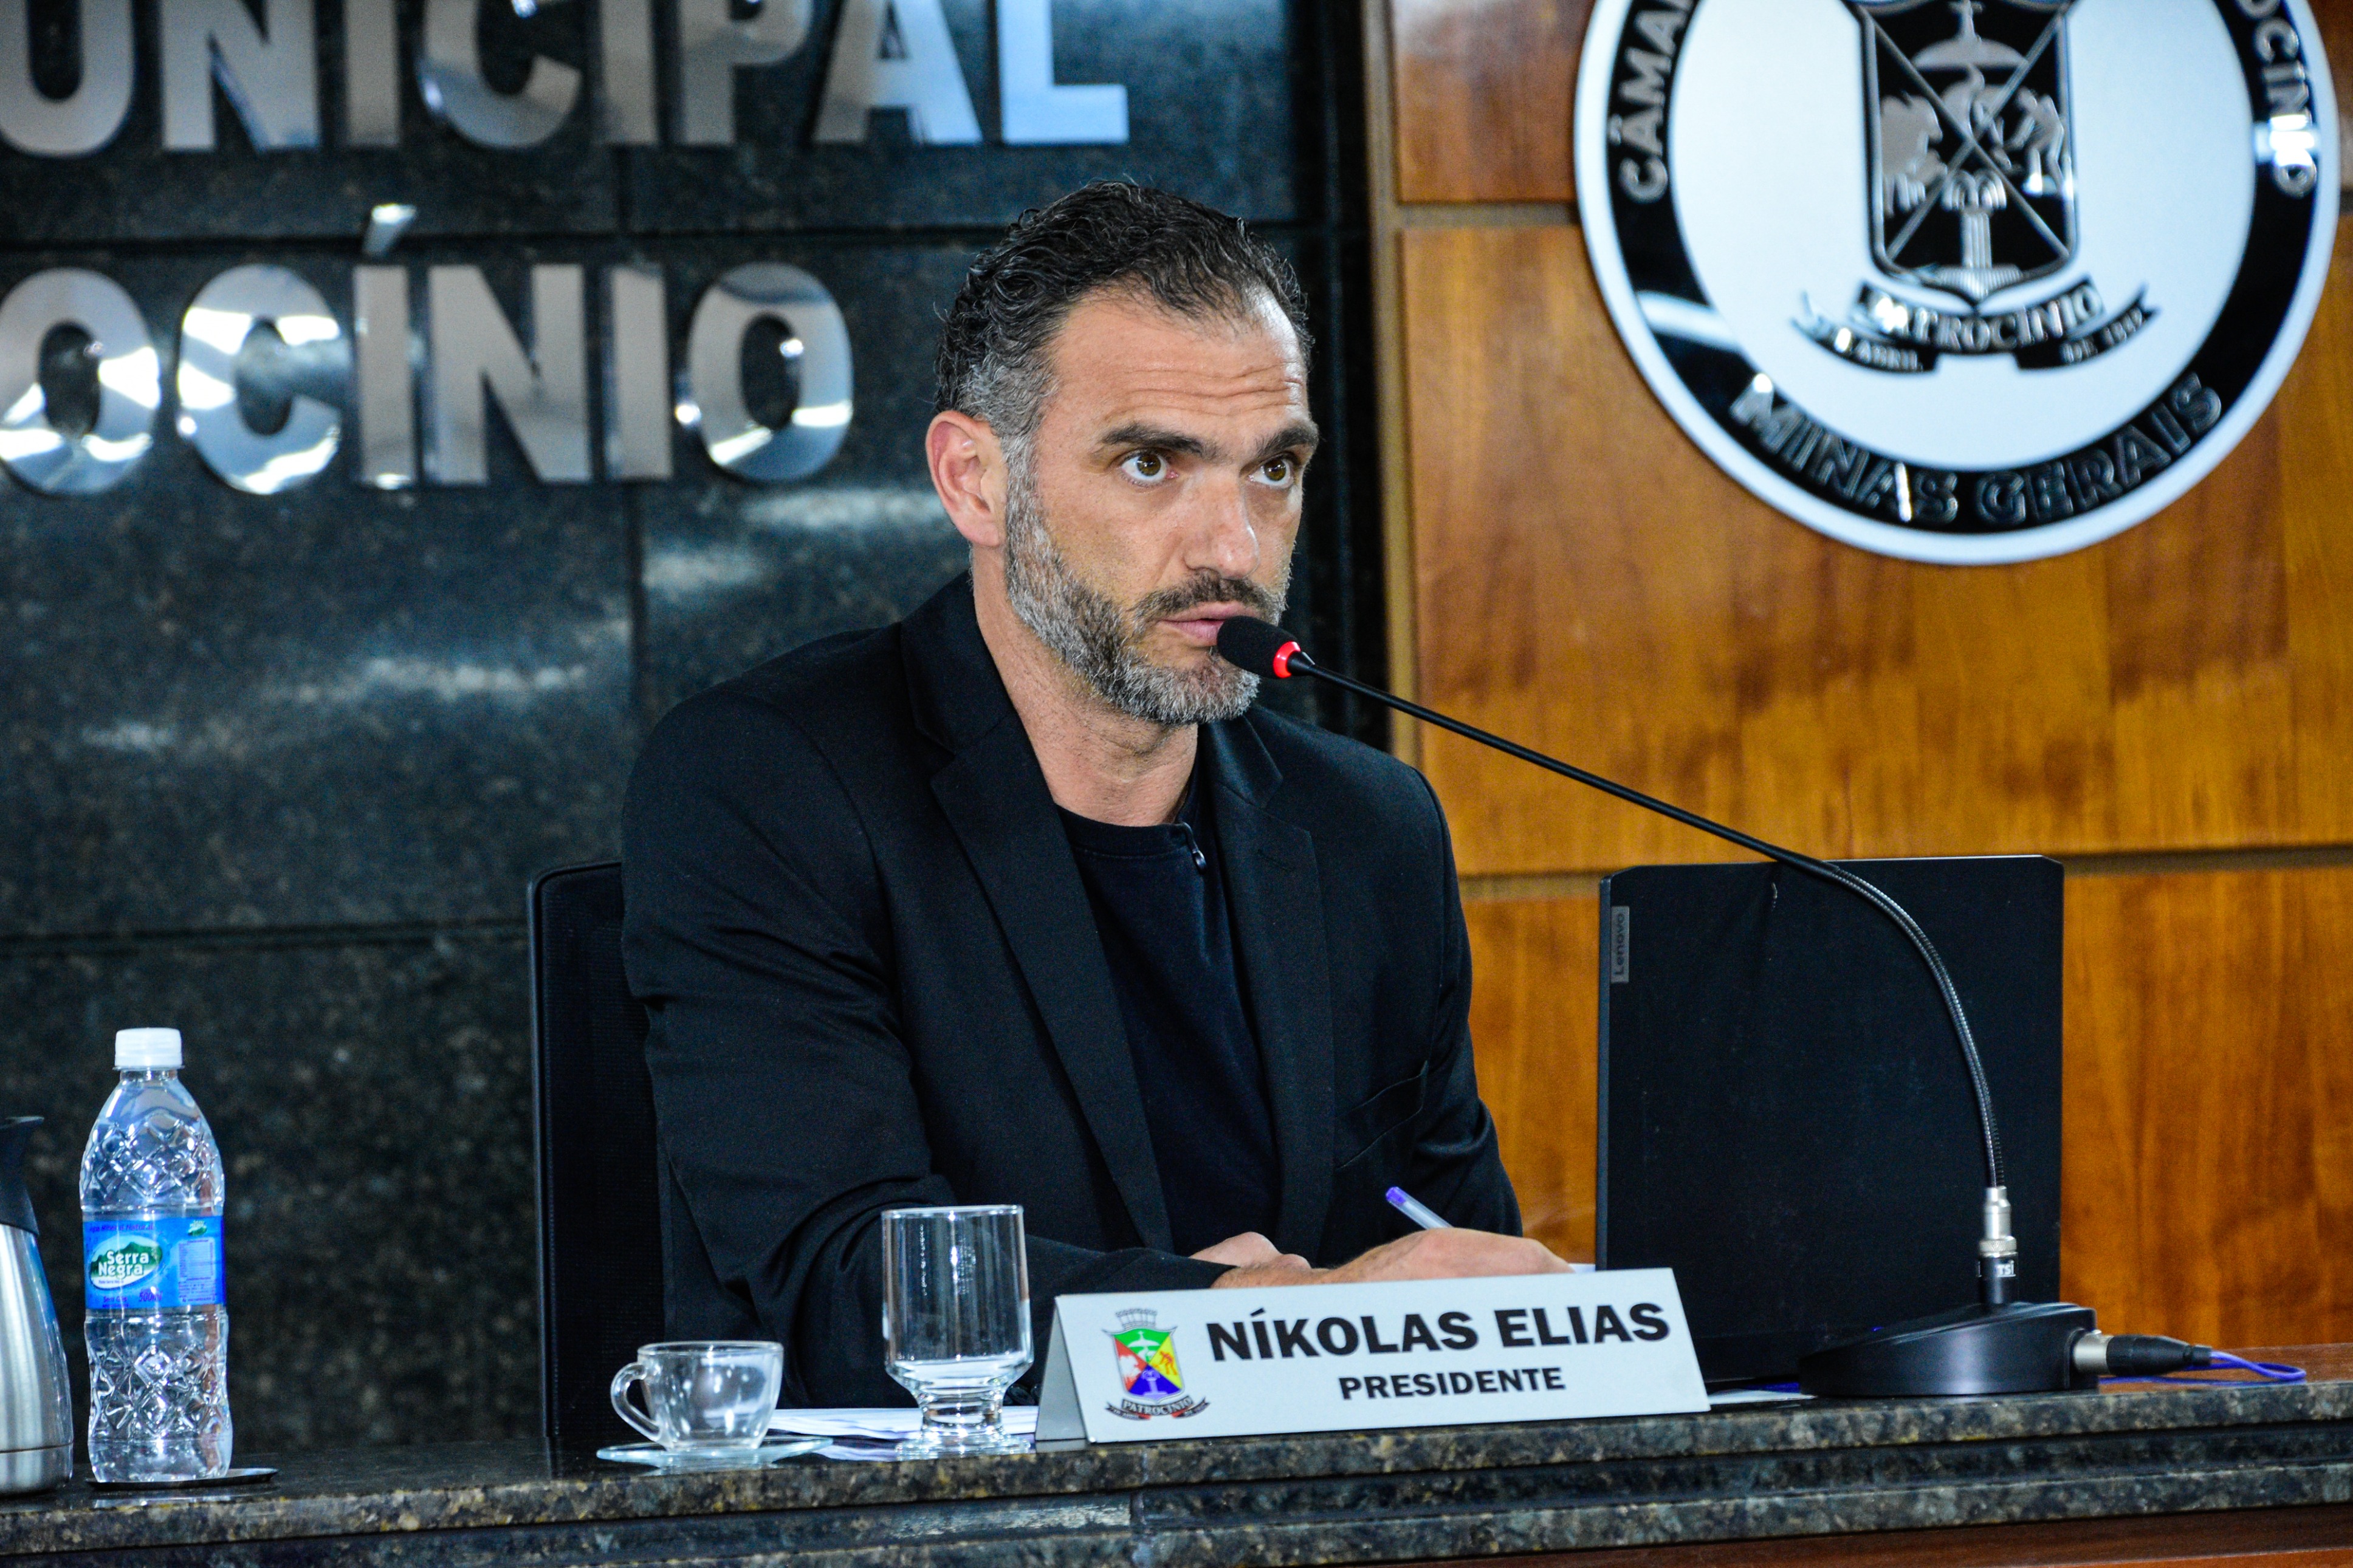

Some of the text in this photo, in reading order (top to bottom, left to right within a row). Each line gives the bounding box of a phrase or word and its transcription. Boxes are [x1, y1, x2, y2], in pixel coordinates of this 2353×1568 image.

[1608, 0, 1693, 203] CÂMA
[0, 204, 853, 494] OCÍNIO
[1730, 371, 2222, 526] MINAS GERAIS
[1614, 912, 1625, 974] Lenovo
[98, 1261, 143, 1280] Negra
[106, 1250, 149, 1265] Serra
[1206, 1303, 1671, 1362] NÍKOLAS ELIAS
[1339, 1367, 1566, 1400] PRESIDENTE
